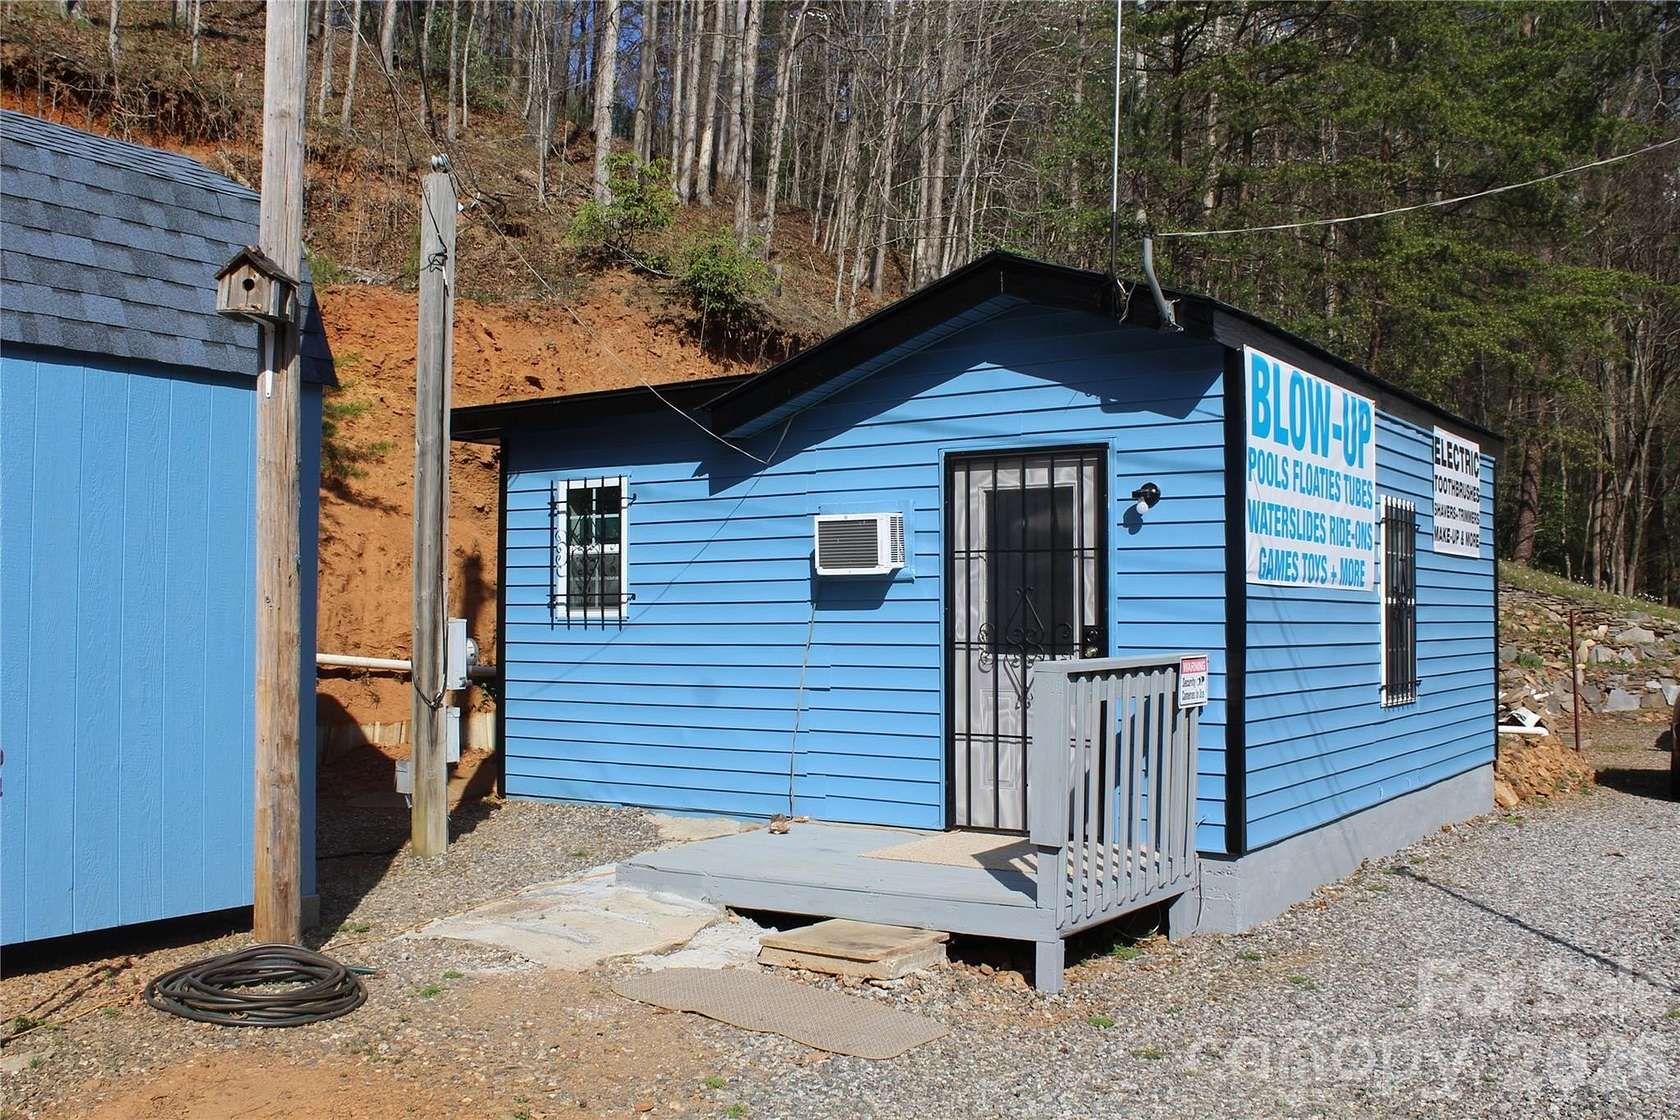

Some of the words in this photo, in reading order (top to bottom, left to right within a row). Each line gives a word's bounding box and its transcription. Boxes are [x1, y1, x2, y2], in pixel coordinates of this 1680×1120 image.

[1250, 352, 1372, 469] BLOW-UP
[1434, 436, 1480, 478] ELECTRIC
[1247, 446, 1289, 490] POOLS
[1293, 459, 1341, 502] FLOATIES
[1343, 473, 1373, 510] TUBES
[1434, 474, 1480, 503] TOOTHBRUSHES
[1247, 498, 1327, 544] WATERSLIDES
[1329, 515, 1373, 551] RIDE-ONS
[1434, 525, 1460, 544] MAKE-UP
[1465, 531, 1480, 548] MORE
[1258, 546, 1299, 582] GAMES
[1301, 552, 1328, 584] TOYS
[1339, 558, 1365, 587] MORE
[1182, 660, 1206, 672] WARNING
